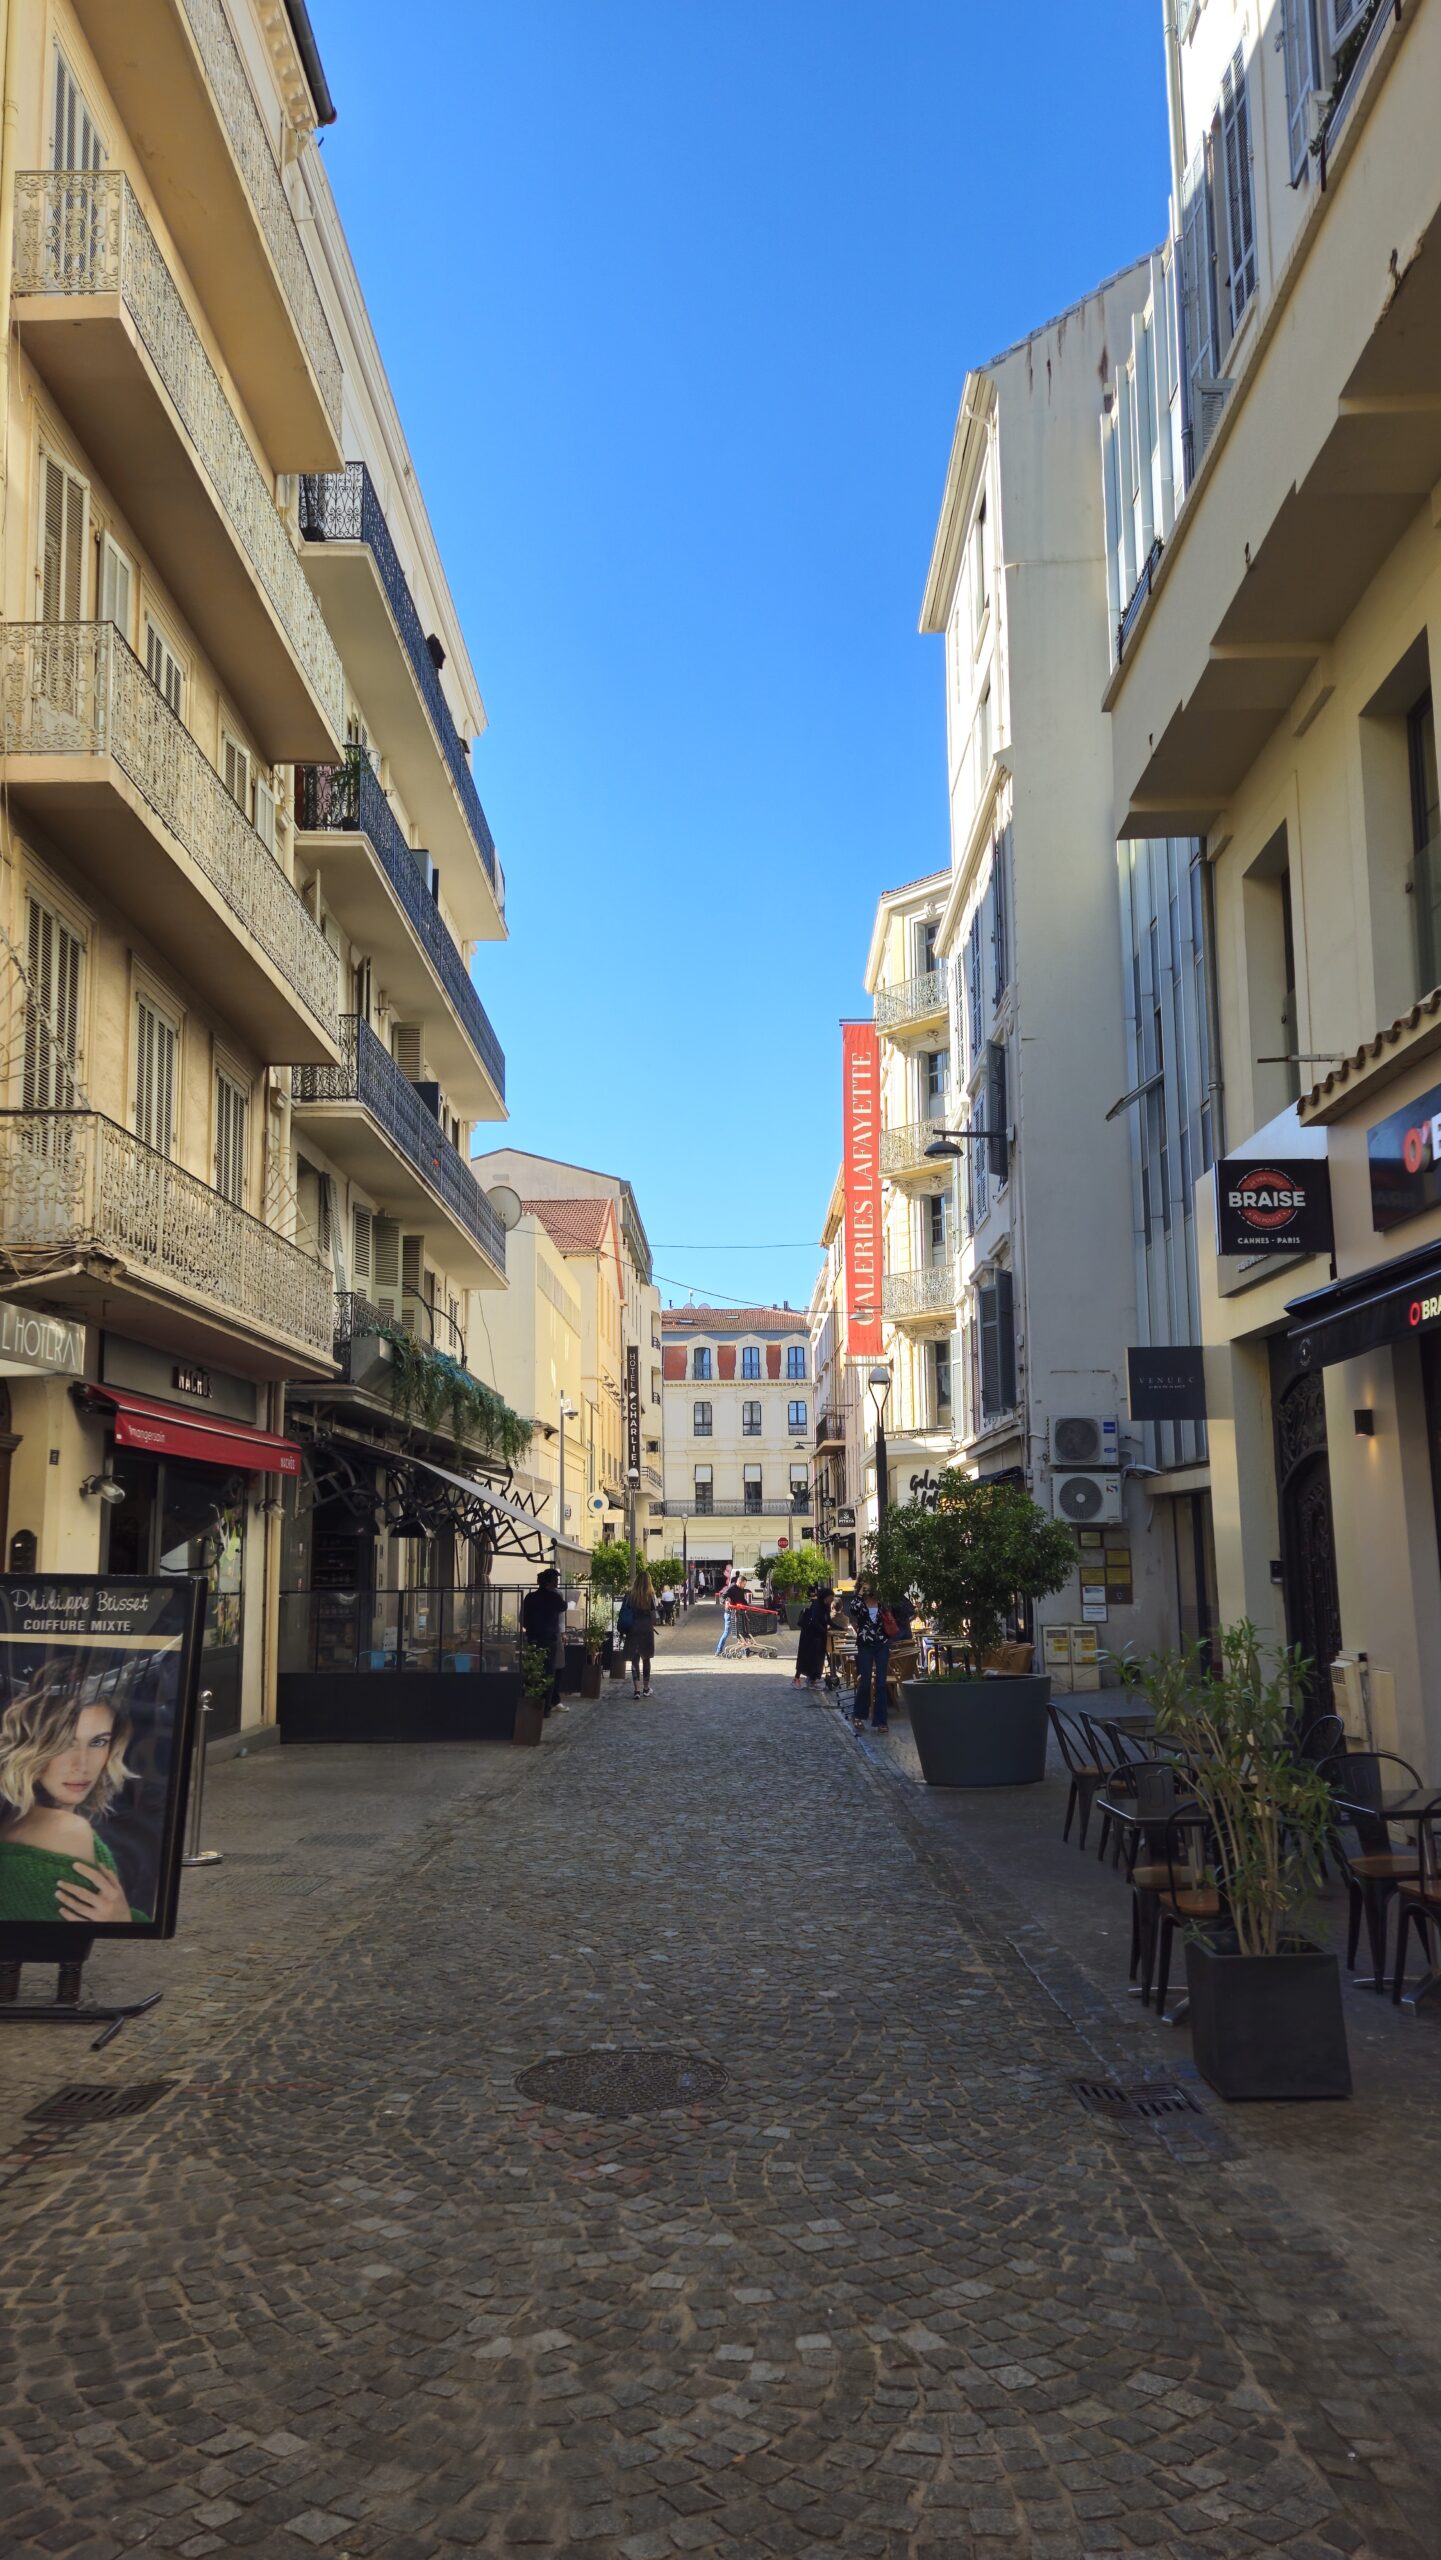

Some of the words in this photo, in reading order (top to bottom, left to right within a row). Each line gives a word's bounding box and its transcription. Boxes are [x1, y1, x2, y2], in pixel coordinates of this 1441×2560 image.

[852, 1052, 873, 1191] LAFAYETTE
[852, 1200, 875, 1326] GALERIES
[629, 1353, 638, 1389] HOTEL
[23, 1619, 85, 1631] COIFFURE
[90, 1620, 131, 1632] MIXTE
